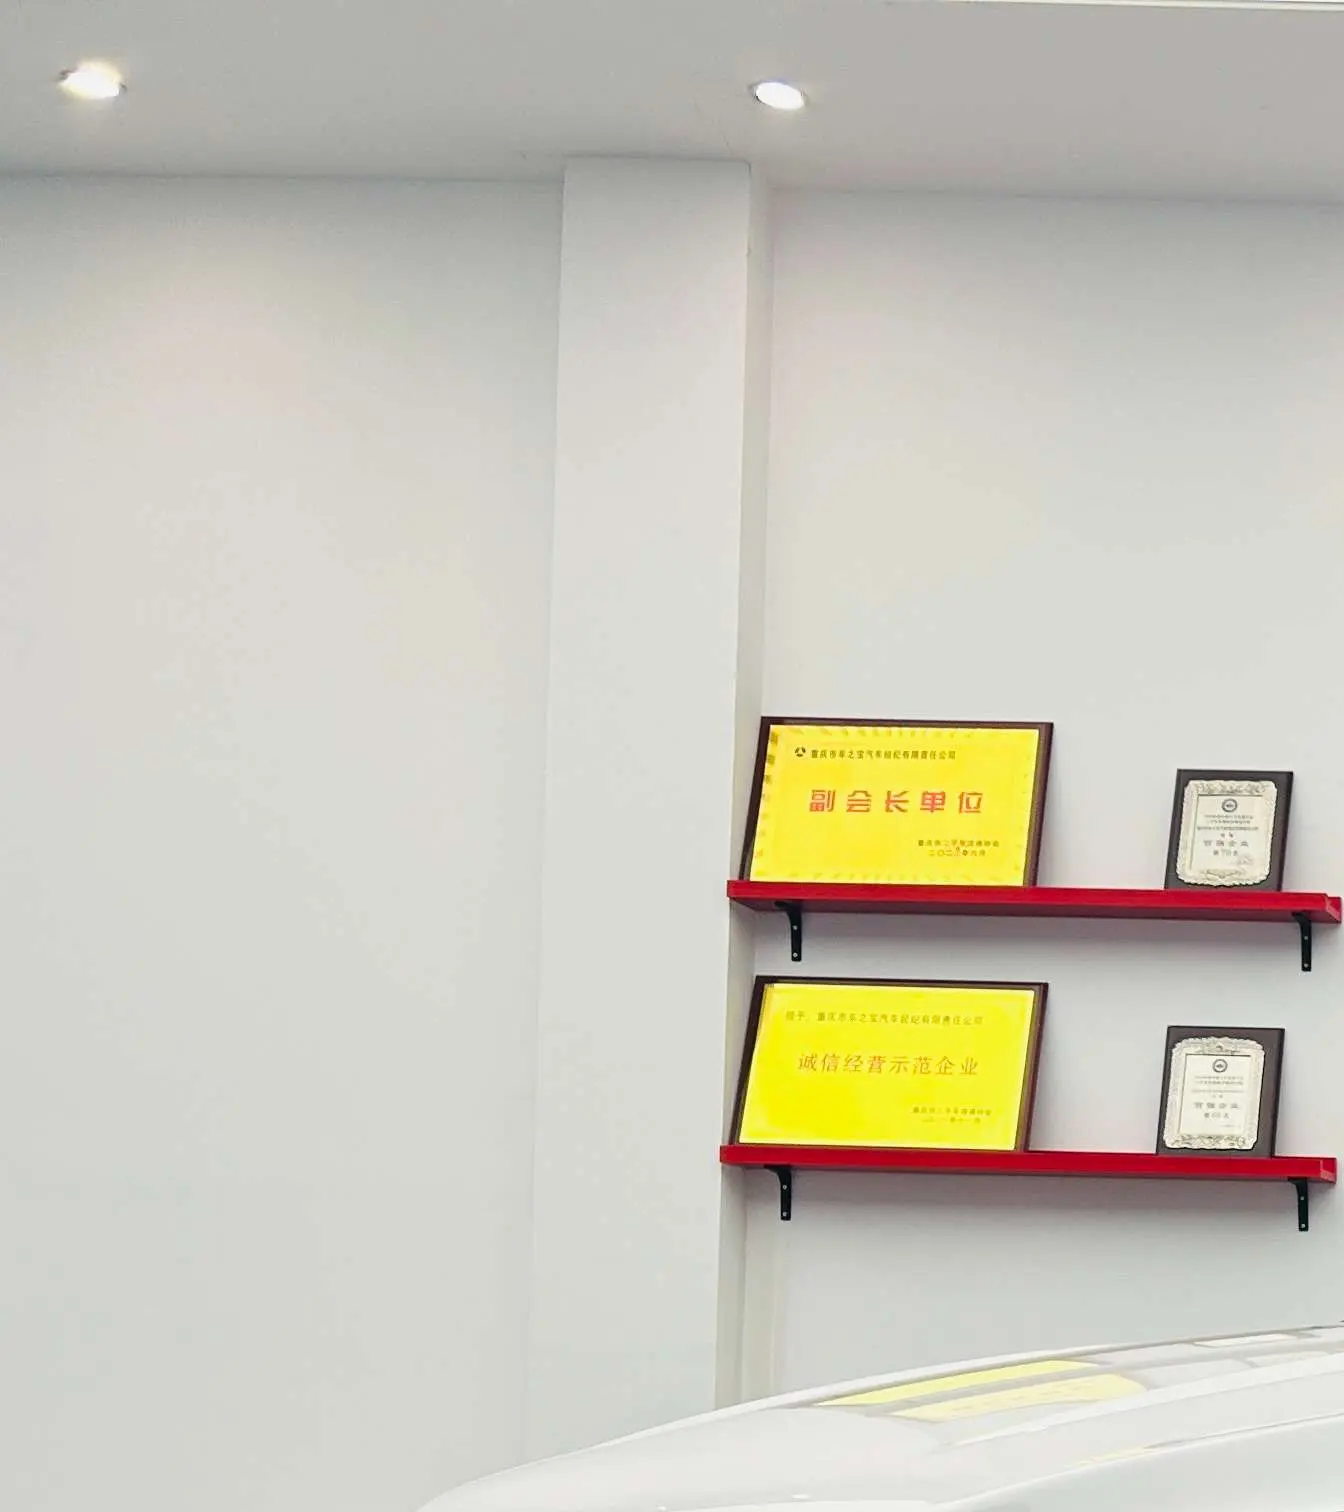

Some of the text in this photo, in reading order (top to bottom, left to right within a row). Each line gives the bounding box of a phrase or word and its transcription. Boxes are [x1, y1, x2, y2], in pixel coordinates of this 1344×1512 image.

[809, 789, 983, 814] 副会长单位
[797, 1053, 979, 1076] 诚信经营示范企业
